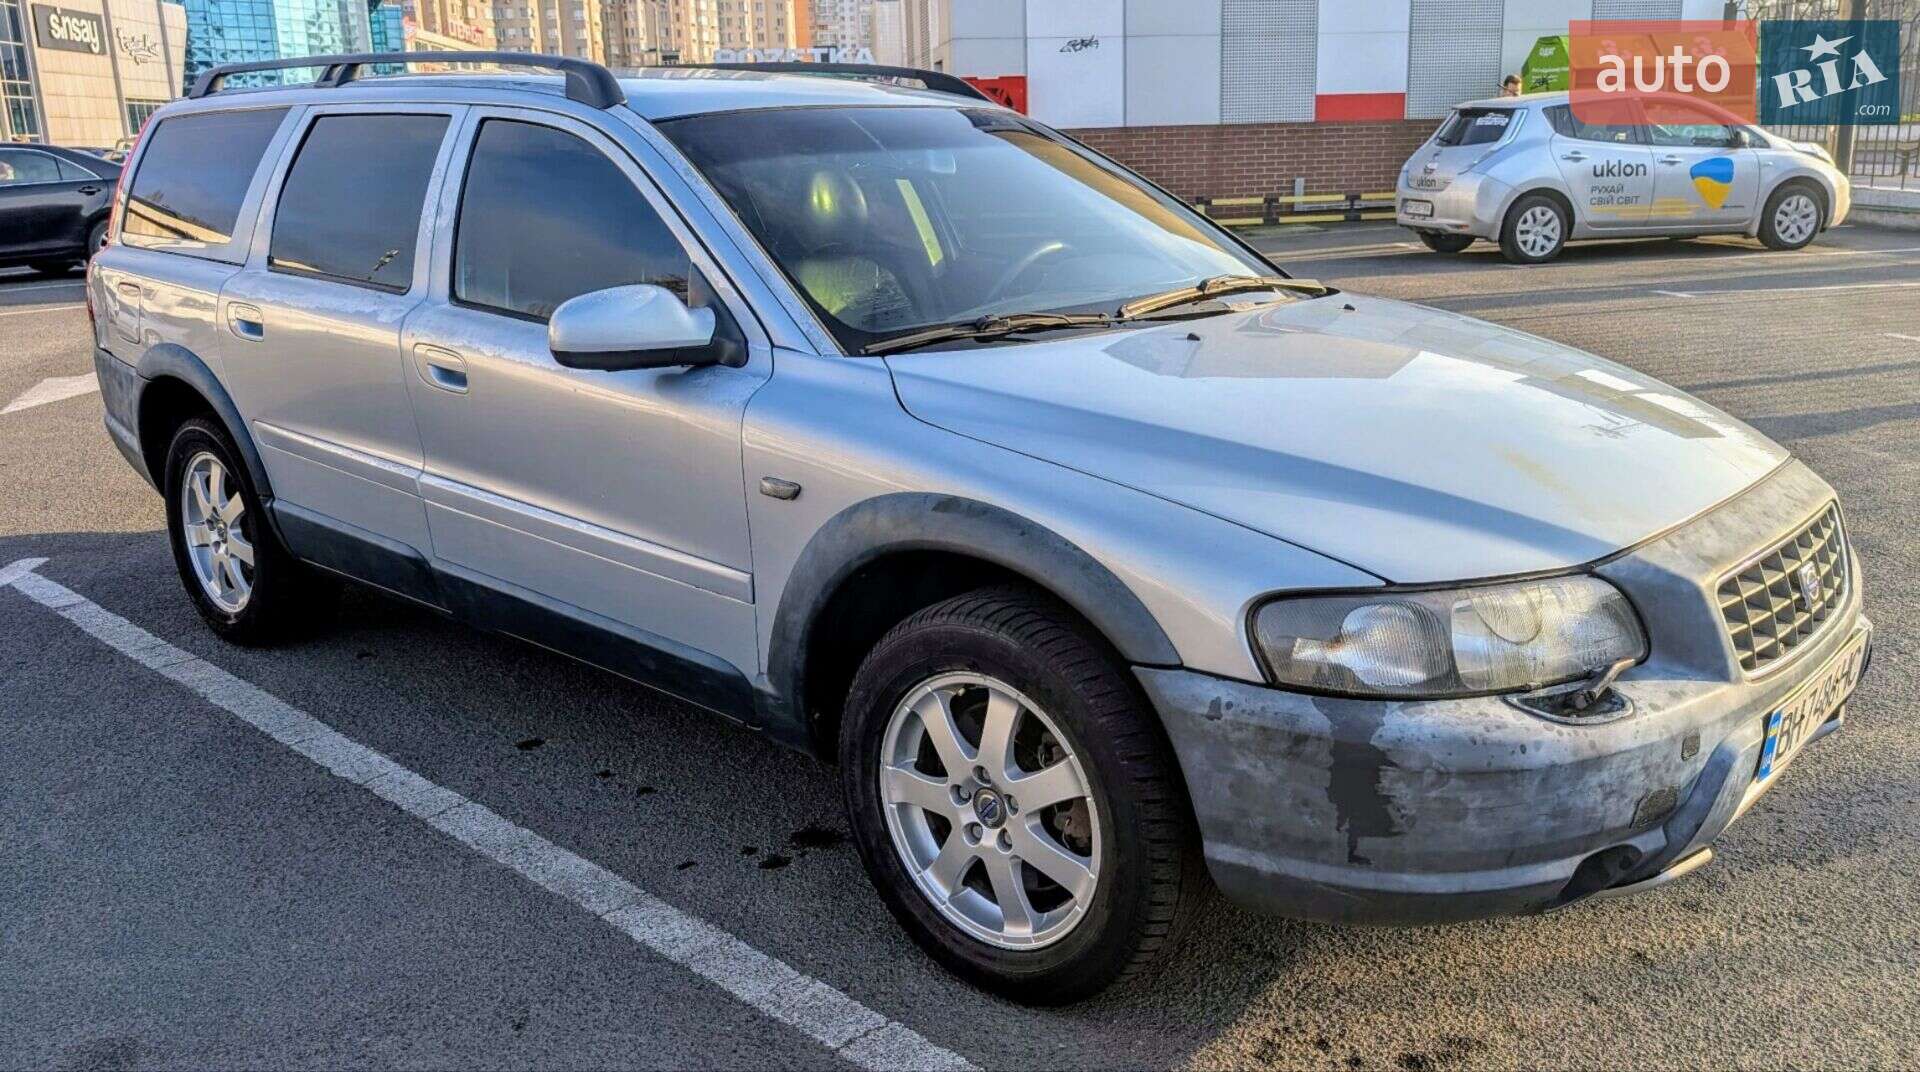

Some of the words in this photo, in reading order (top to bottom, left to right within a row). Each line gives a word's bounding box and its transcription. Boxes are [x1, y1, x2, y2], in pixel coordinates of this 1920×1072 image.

[49, 8, 101, 54] sinsay
[1593, 159, 1647, 177] uklon
[1416, 176, 1436, 188] uklon
